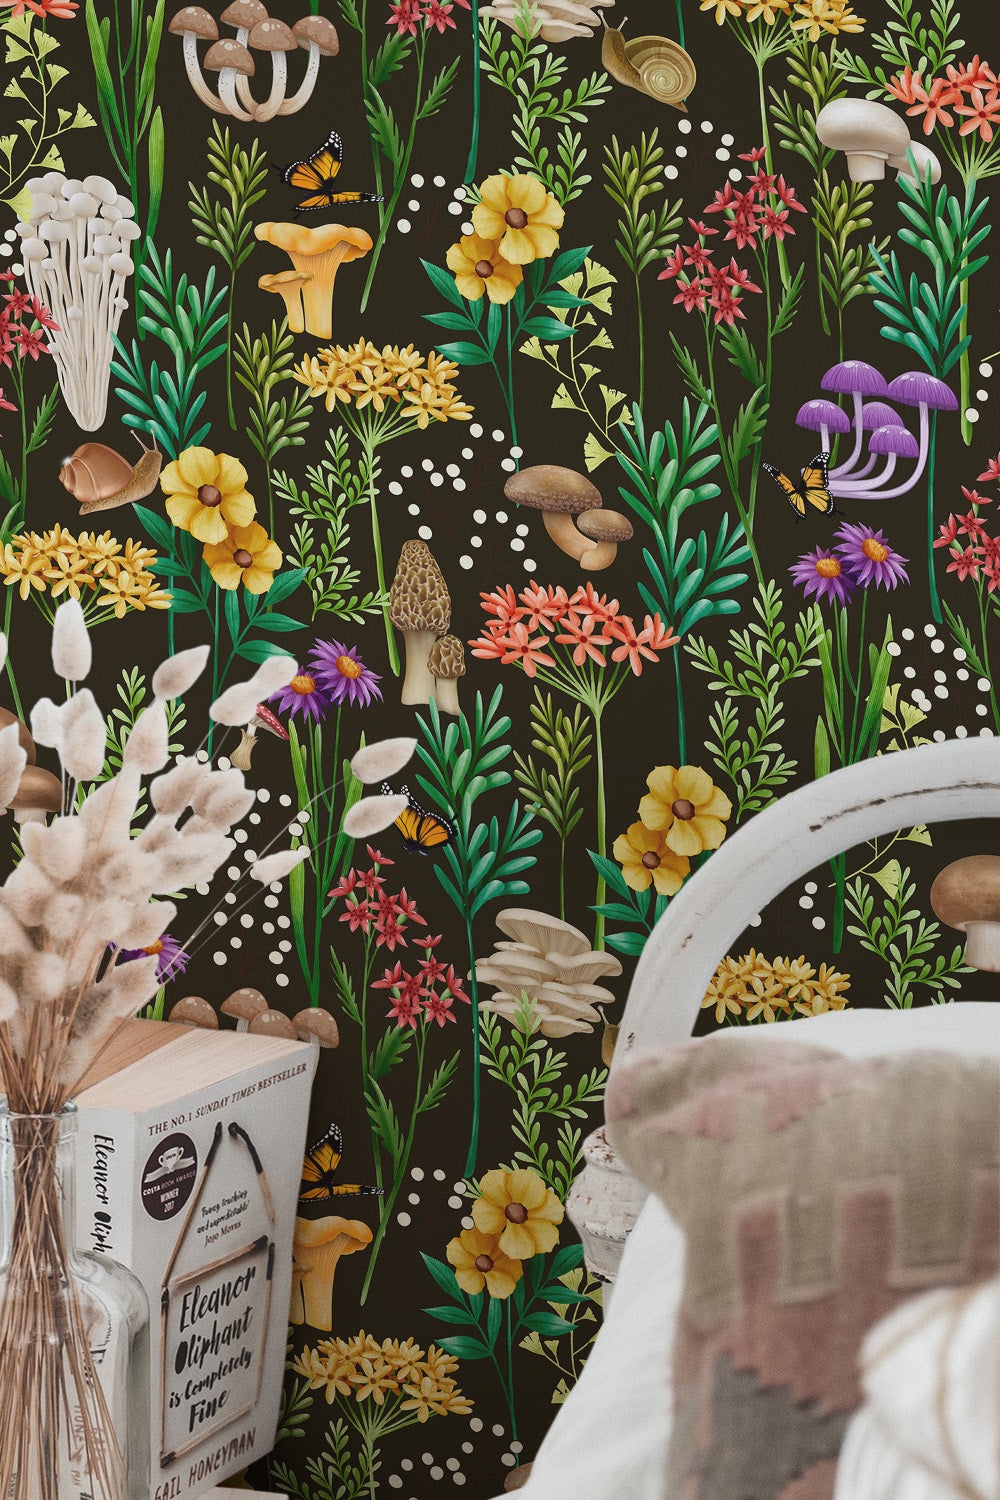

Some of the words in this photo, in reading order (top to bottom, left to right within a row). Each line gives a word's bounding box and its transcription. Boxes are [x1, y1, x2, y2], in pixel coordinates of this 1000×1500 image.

[148, 1121, 169, 1136] THE
[195, 1095, 230, 1118] SUNDAY
[231, 1086, 256, 1103] TIMES
[257, 1063, 307, 1091] BESTSELLER
[93, 1134, 115, 1205] Eleanor
[143, 1185, 161, 1196] COSTA
[161, 1179, 175, 1189] BOOK
[160, 1188, 179, 1203] WINNER
[90, 1211, 113, 1253] Oliph
[197, 1219, 210, 1234] and
[204, 1233, 219, 1248] Jojo
[180, 1266, 256, 1333] Eleanor
[174, 1305, 253, 1374] Oliphant
[169, 1391, 181, 1409] is
[184, 1347, 252, 1400] Completely
[189, 1390, 228, 1433] Fine
[188, 1427, 257, 1487] HONEYMAN
